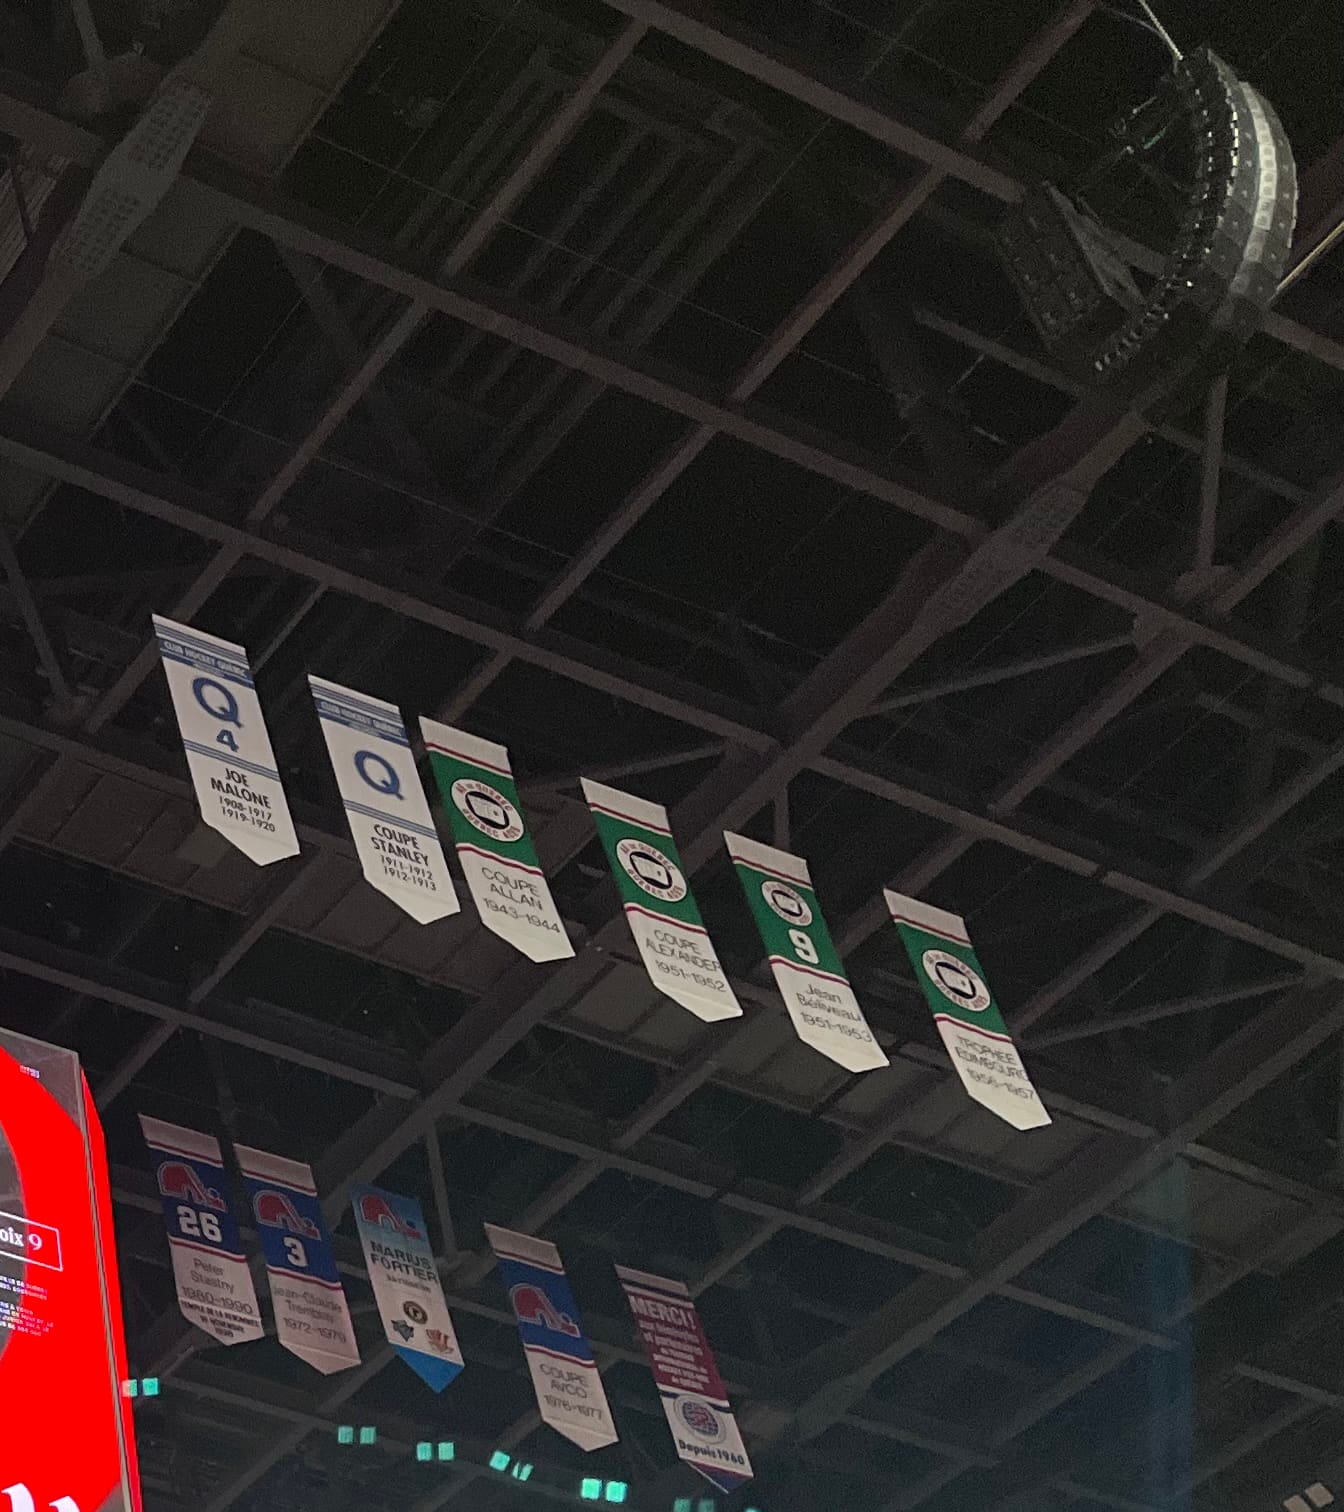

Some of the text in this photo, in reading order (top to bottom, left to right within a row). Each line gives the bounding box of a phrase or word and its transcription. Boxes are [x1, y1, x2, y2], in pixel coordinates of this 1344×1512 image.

[192, 676, 244, 728] Q
[216, 729, 240, 752] 4
[224, 767, 250, 788] JOE
[354, 749, 405, 801] Q
[210, 777, 272, 809] MALONE
[373, 823, 419, 850] COUPE
[370, 836, 429, 867] STANLEY
[481, 866, 539, 896] COUPE
[489, 882, 543, 911] ALLAN
[653, 929, 702, 955] COUPE
[788, 928, 819, 965] 9
[176, 1204, 223, 1243] 26
[28, 1232, 43, 1251] 9
[282, 1236, 309, 1267] 3
[370, 1240, 432, 1269] MARIUS
[193, 1257, 224, 1276] Peter
[371, 1254, 438, 1284] FORTIER
[628, 1294, 697, 1330] MERCI!
[540, 1362, 589, 1388] COUPE
[678, 1438, 745, 1465] Depuis 1960
